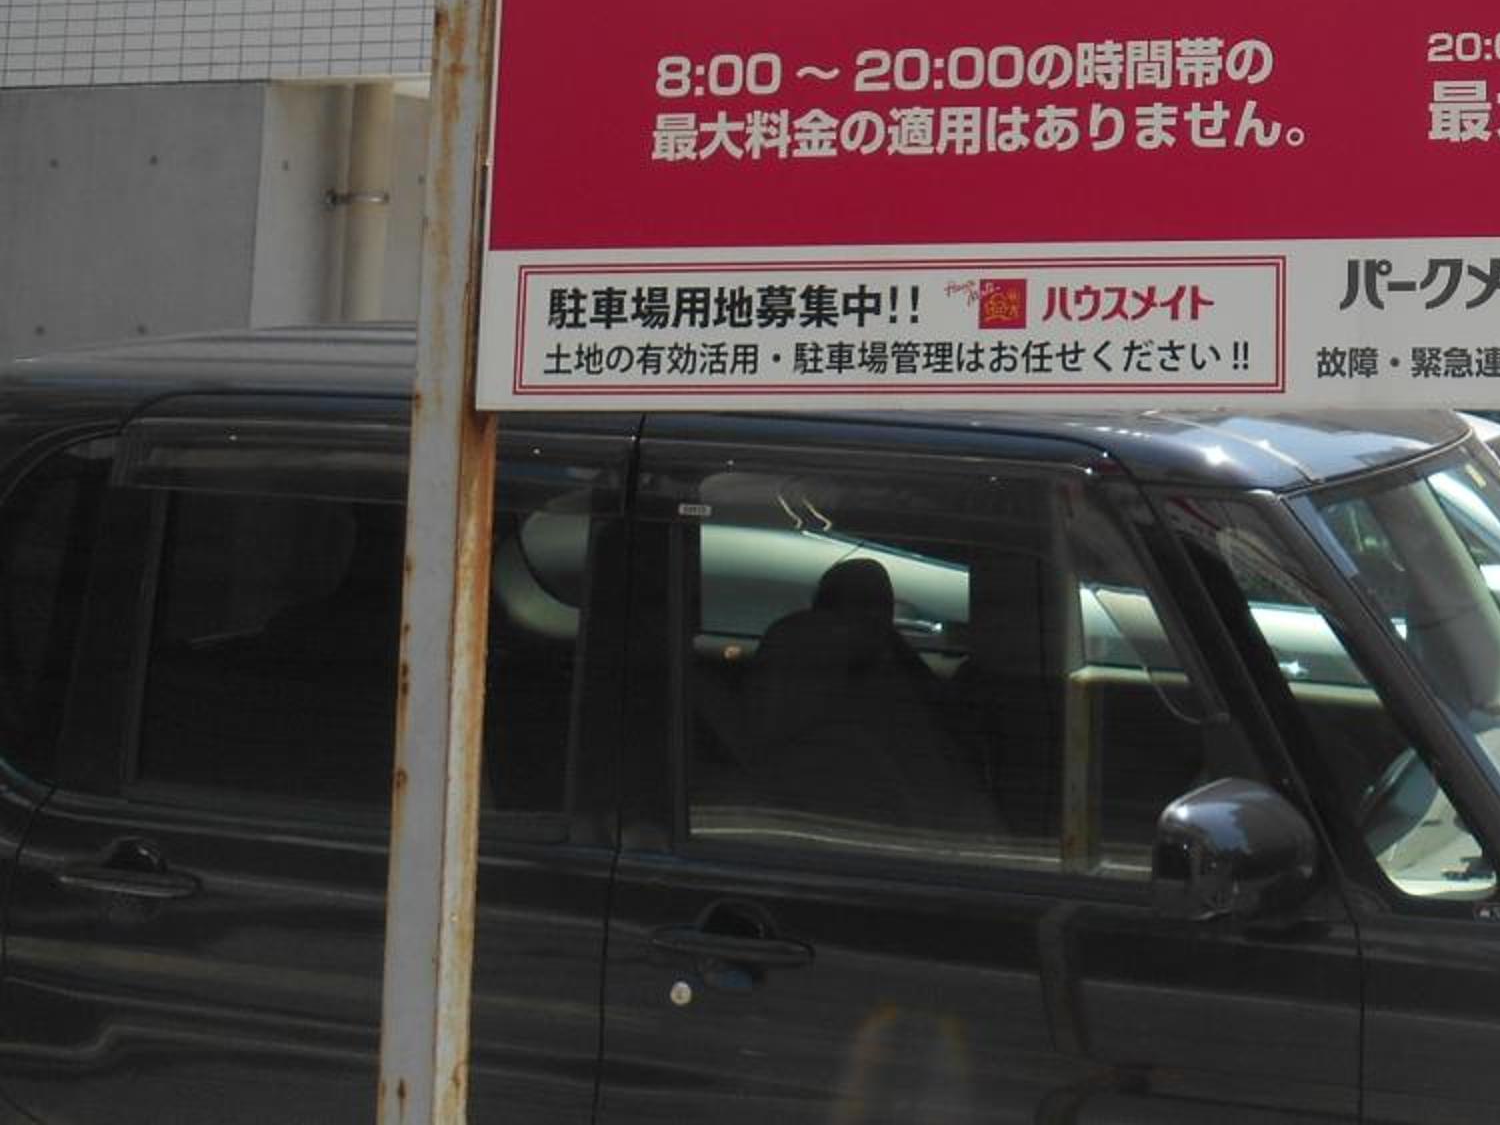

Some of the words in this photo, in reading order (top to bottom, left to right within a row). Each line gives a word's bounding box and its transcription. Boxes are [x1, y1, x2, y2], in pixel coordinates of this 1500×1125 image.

[656, 52, 783, 99] 8:00
[651, 100, 1306, 163] 最大料金の適用はありません。
[547, 284, 921, 330] 駐車場用地募集中!!
[1041, 284, 1215, 322] ハウスメイト
